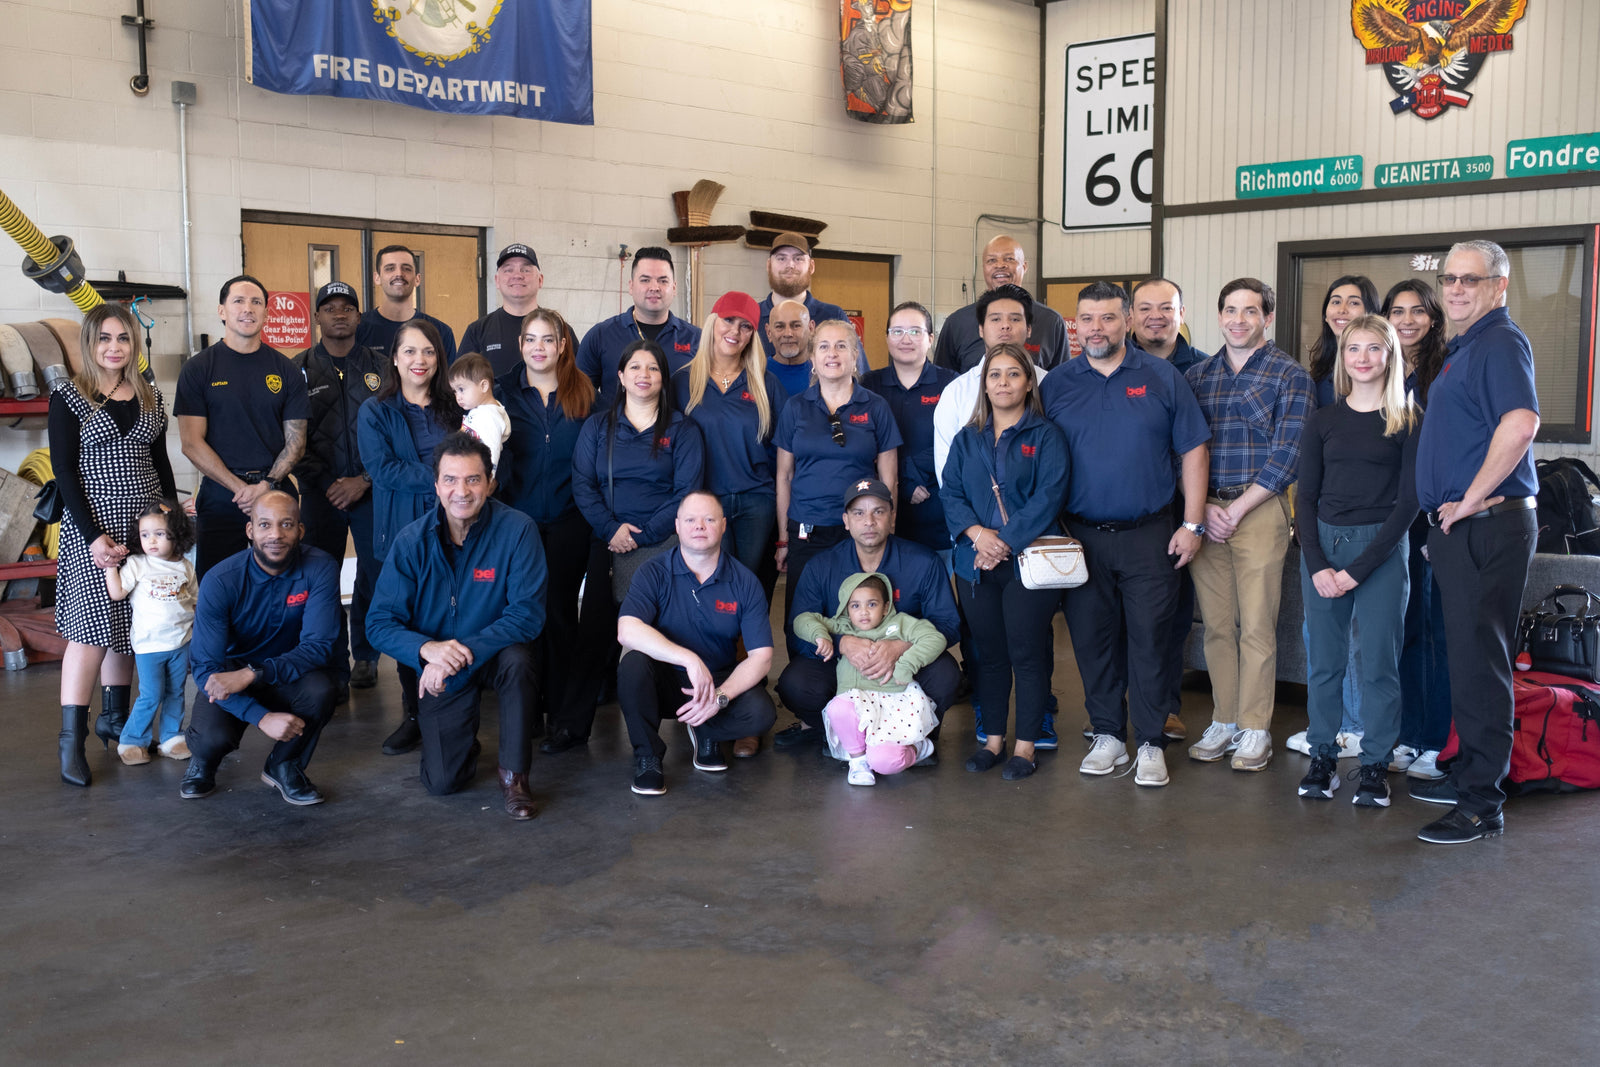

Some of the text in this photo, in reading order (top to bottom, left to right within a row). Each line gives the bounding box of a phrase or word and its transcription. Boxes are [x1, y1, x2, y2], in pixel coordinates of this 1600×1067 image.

[1406, 1, 1465, 24] ENGINE
[1470, 35, 1513, 54] MEDIC
[313, 54, 546, 107] FIRE DEPARTMENT
[1076, 57, 1155, 92] SPEE
[1423, 77, 1438, 85] SW
[1087, 104, 1149, 136] LIMI
[1510, 143, 1600, 170] Fondre
[1334, 158, 1355, 171] AVE
[1240, 164, 1324, 192] Richmond
[1381, 160, 1491, 185] JEANETTA 3500
[1330, 173, 1358, 186] 6000
[327, 286, 349, 295] FIRE
[275, 297, 294, 310] No
[282, 326, 308, 335] Beyond
[1065, 321, 1077, 330] No
[268, 335, 284, 343] This
[474, 568, 495, 578] bel
